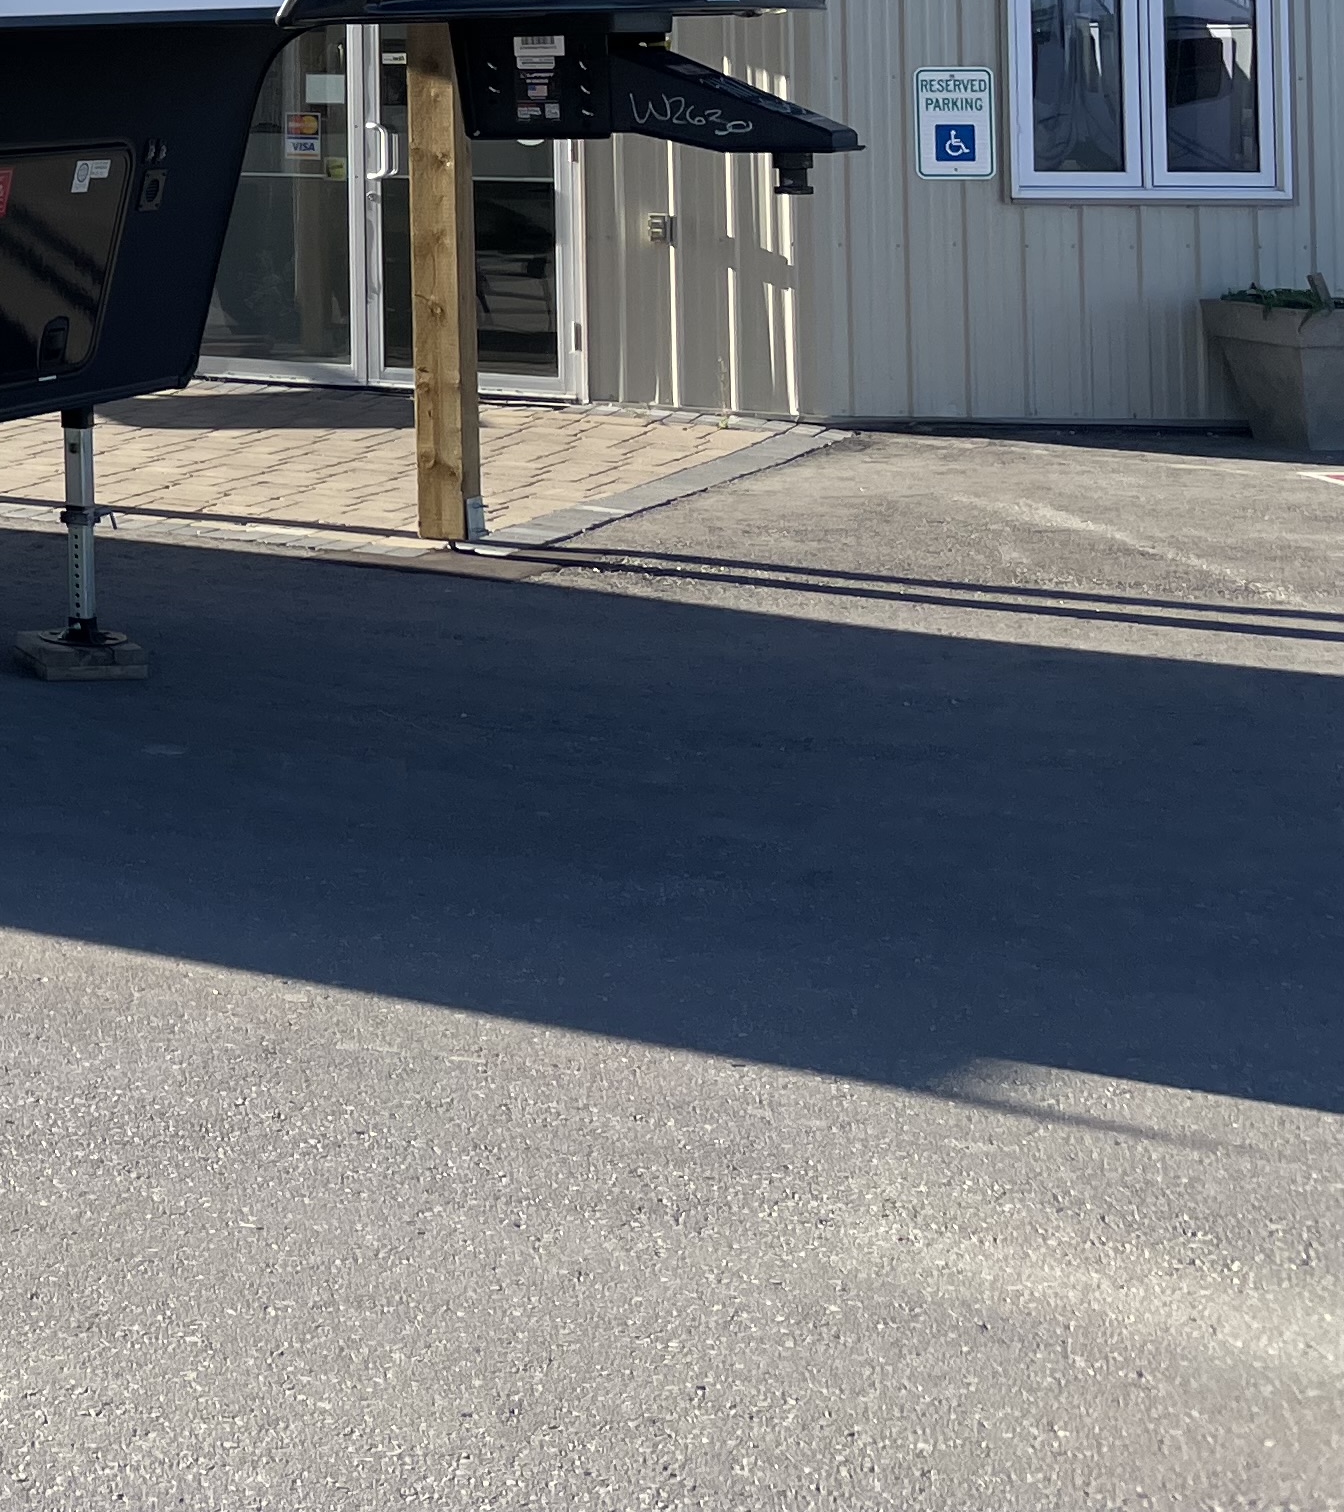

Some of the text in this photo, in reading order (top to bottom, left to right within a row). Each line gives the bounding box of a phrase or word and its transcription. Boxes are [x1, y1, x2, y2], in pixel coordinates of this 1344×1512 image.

[920, 79, 987, 93] RESERVED
[925, 97, 983, 112] PARKING
[292, 142, 316, 152] VISA
